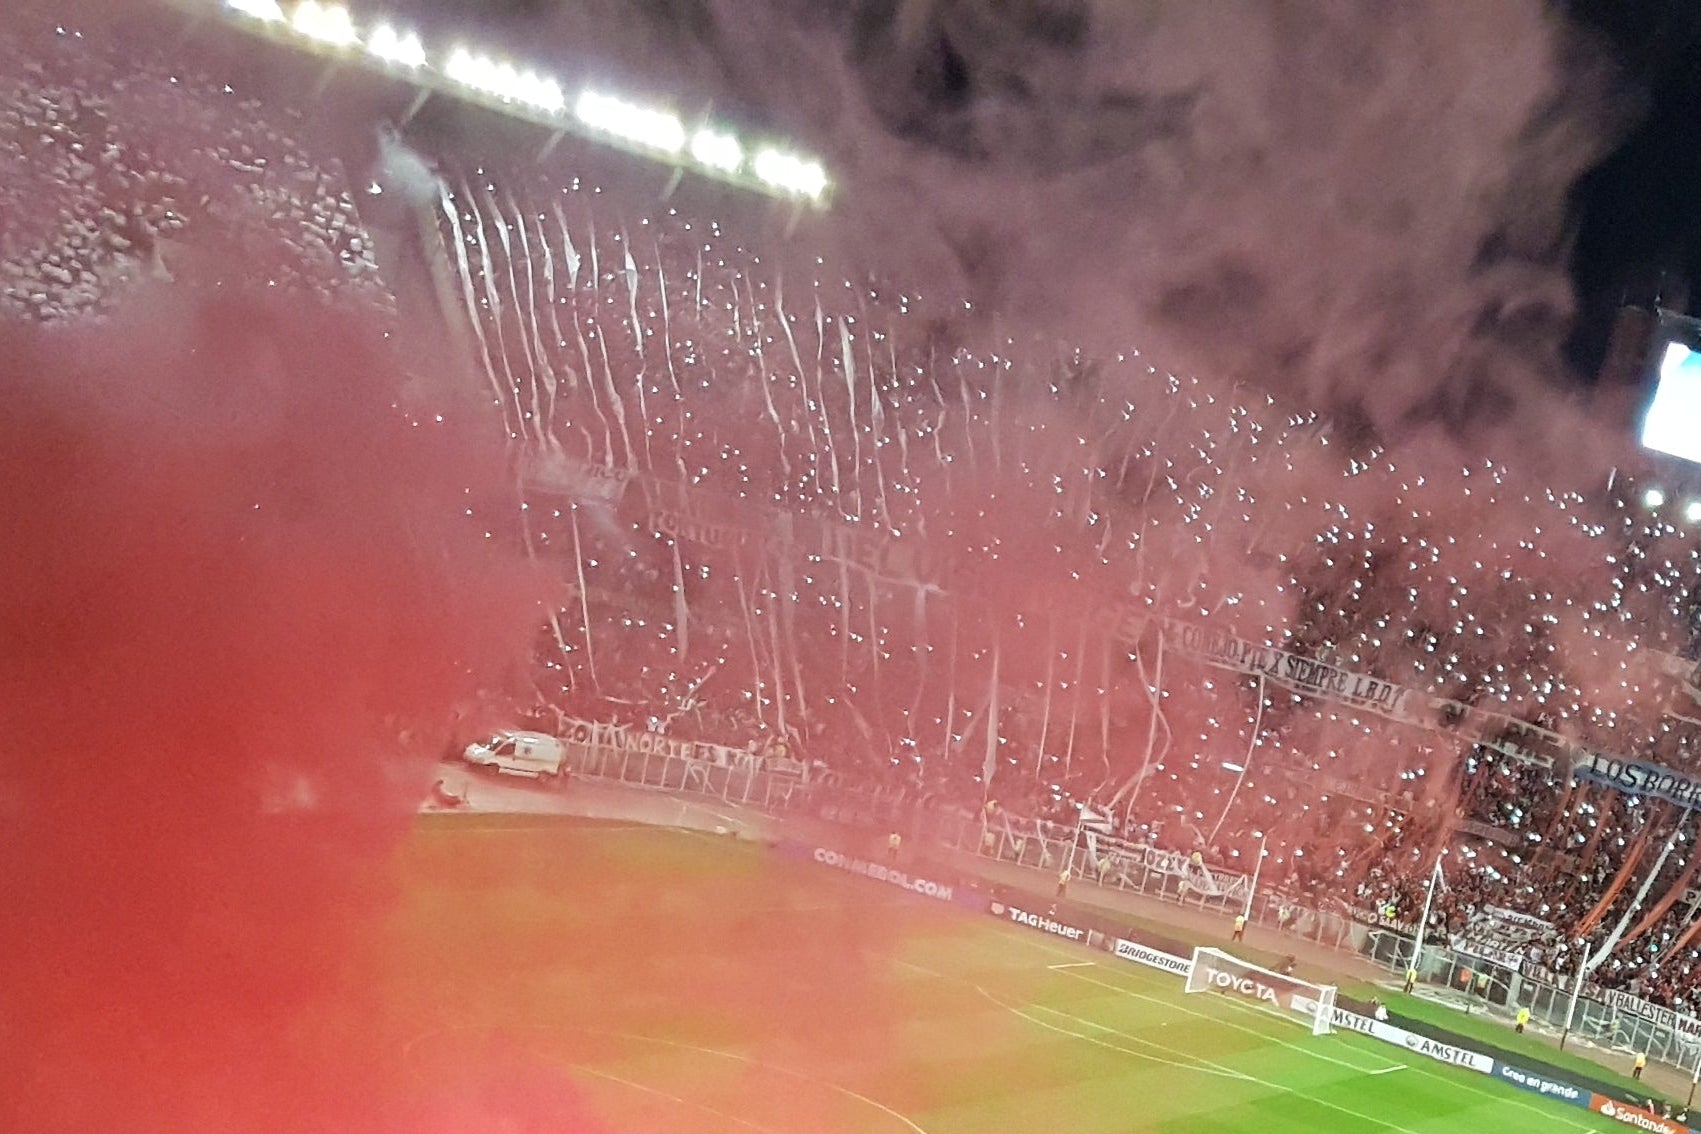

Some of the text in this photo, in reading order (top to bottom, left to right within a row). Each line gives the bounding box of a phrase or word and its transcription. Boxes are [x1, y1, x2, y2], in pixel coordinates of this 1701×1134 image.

[1286, 654, 1348, 694] SIEMPRE
[1591, 752, 1639, 788] LOS
[814, 847, 953, 901] CONMEBOL.COM
[1119, 943, 1190, 974] BRIDGESTONE
[1206, 968, 1280, 1007] TOYOTA
[1333, 1006, 1376, 1034] MSTEL
[1420, 1039, 1477, 1068] AMSTEL
[1502, 1066, 1580, 1100] Cree en grande
